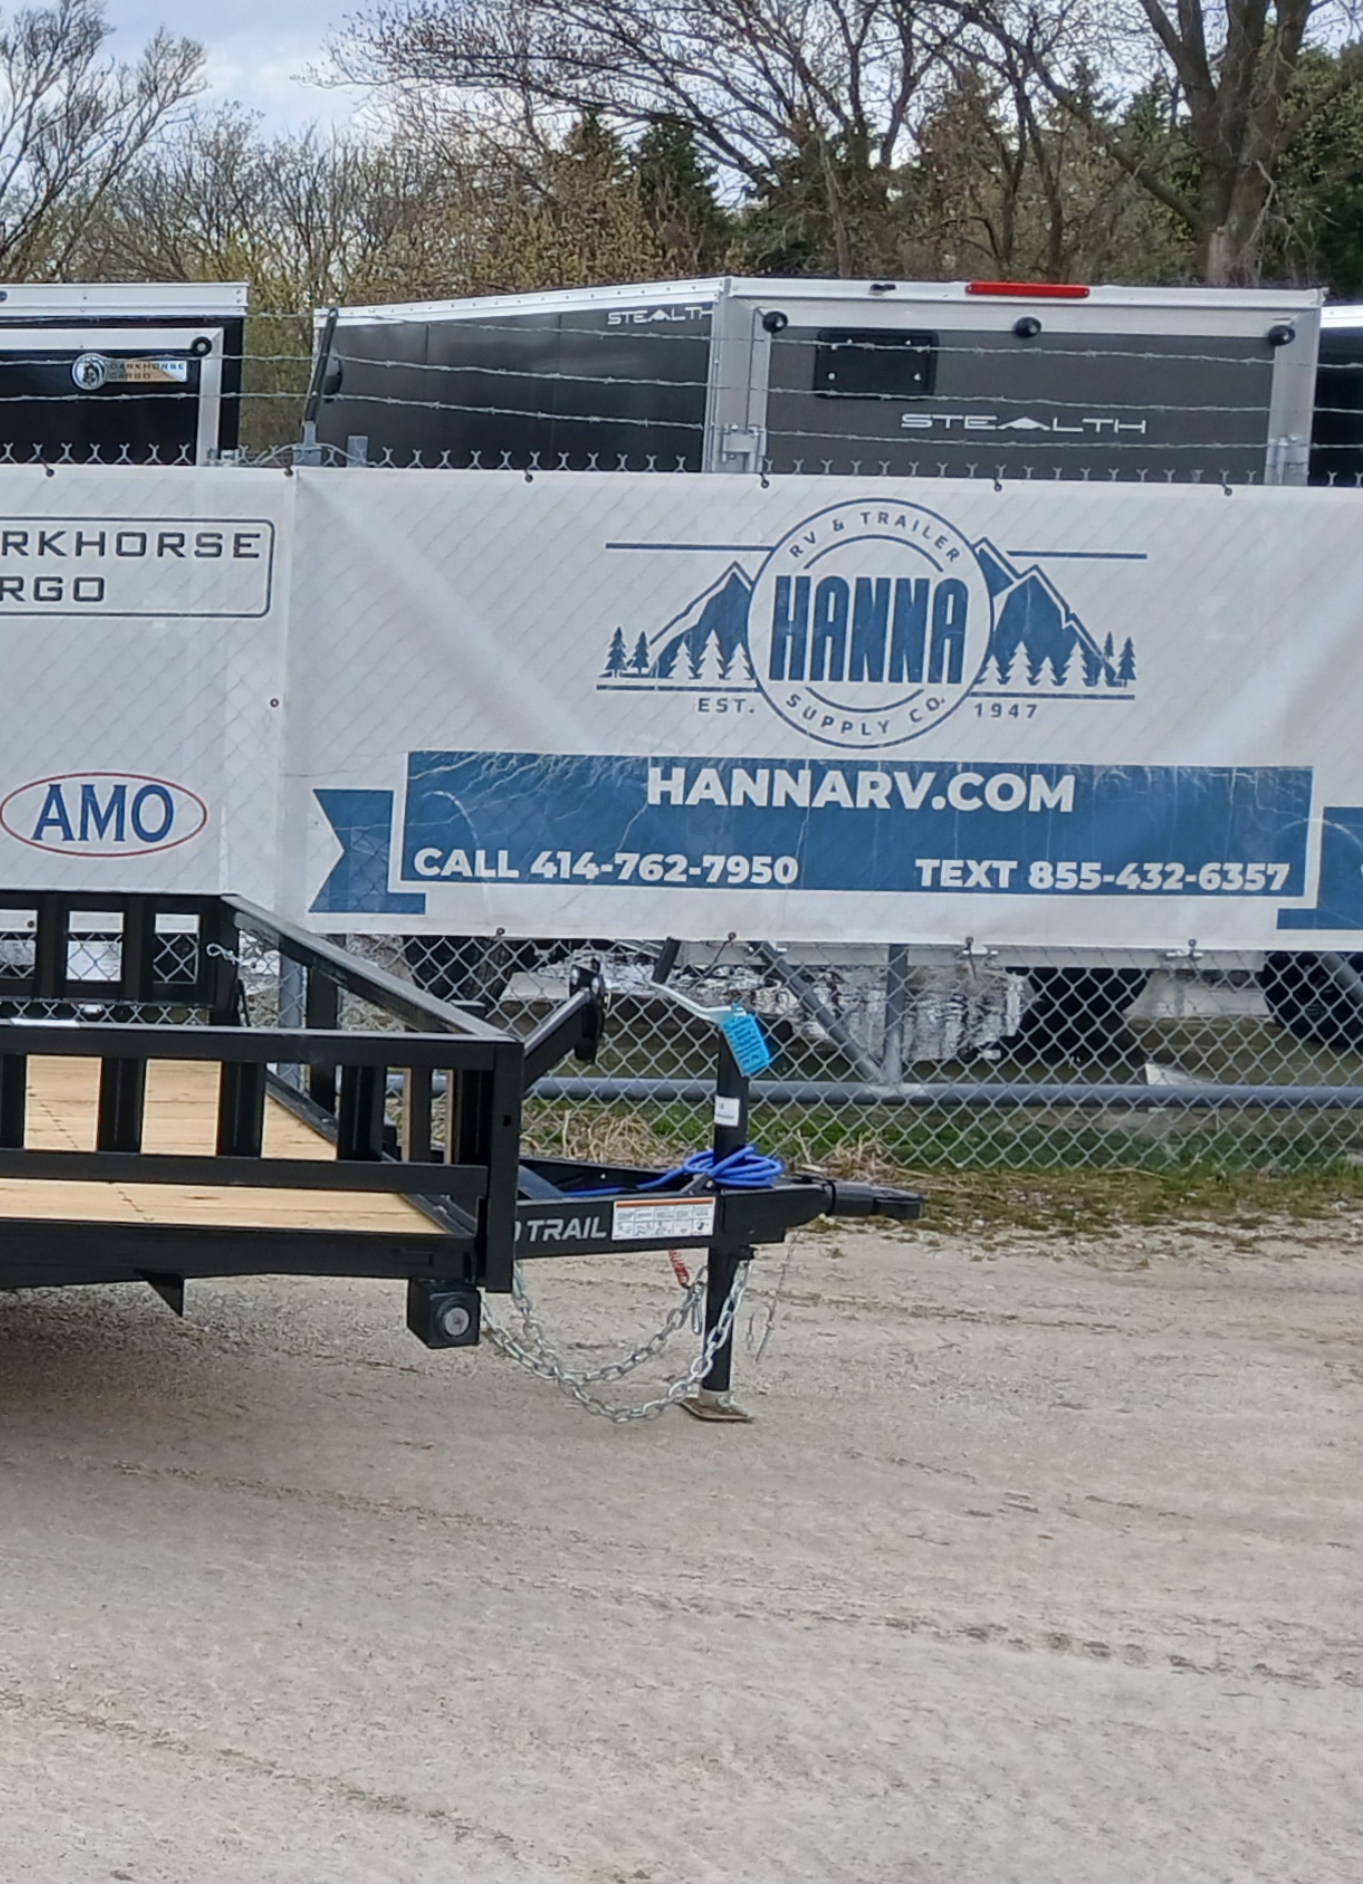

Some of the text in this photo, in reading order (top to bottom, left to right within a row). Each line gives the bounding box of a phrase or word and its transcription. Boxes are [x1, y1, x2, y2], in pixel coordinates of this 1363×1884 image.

[901, 413, 1147, 434] STEALTH
[789, 511, 961, 562] RV & TRAILER
[769, 575, 969, 684] HANNA
[698, 698, 756, 714] EST.
[786, 693, 946, 736] SUPPLY CO.
[975, 702, 1038, 719] 1947
[647, 767, 1075, 812] HANNARV.COM
[31, 784, 174, 843] AMO
[413, 848, 799, 884] CALL 414-762-7950
[915, 859, 1290, 891] TEXT 855-432-6357
[527, 1216, 607, 1242] TRAIL
